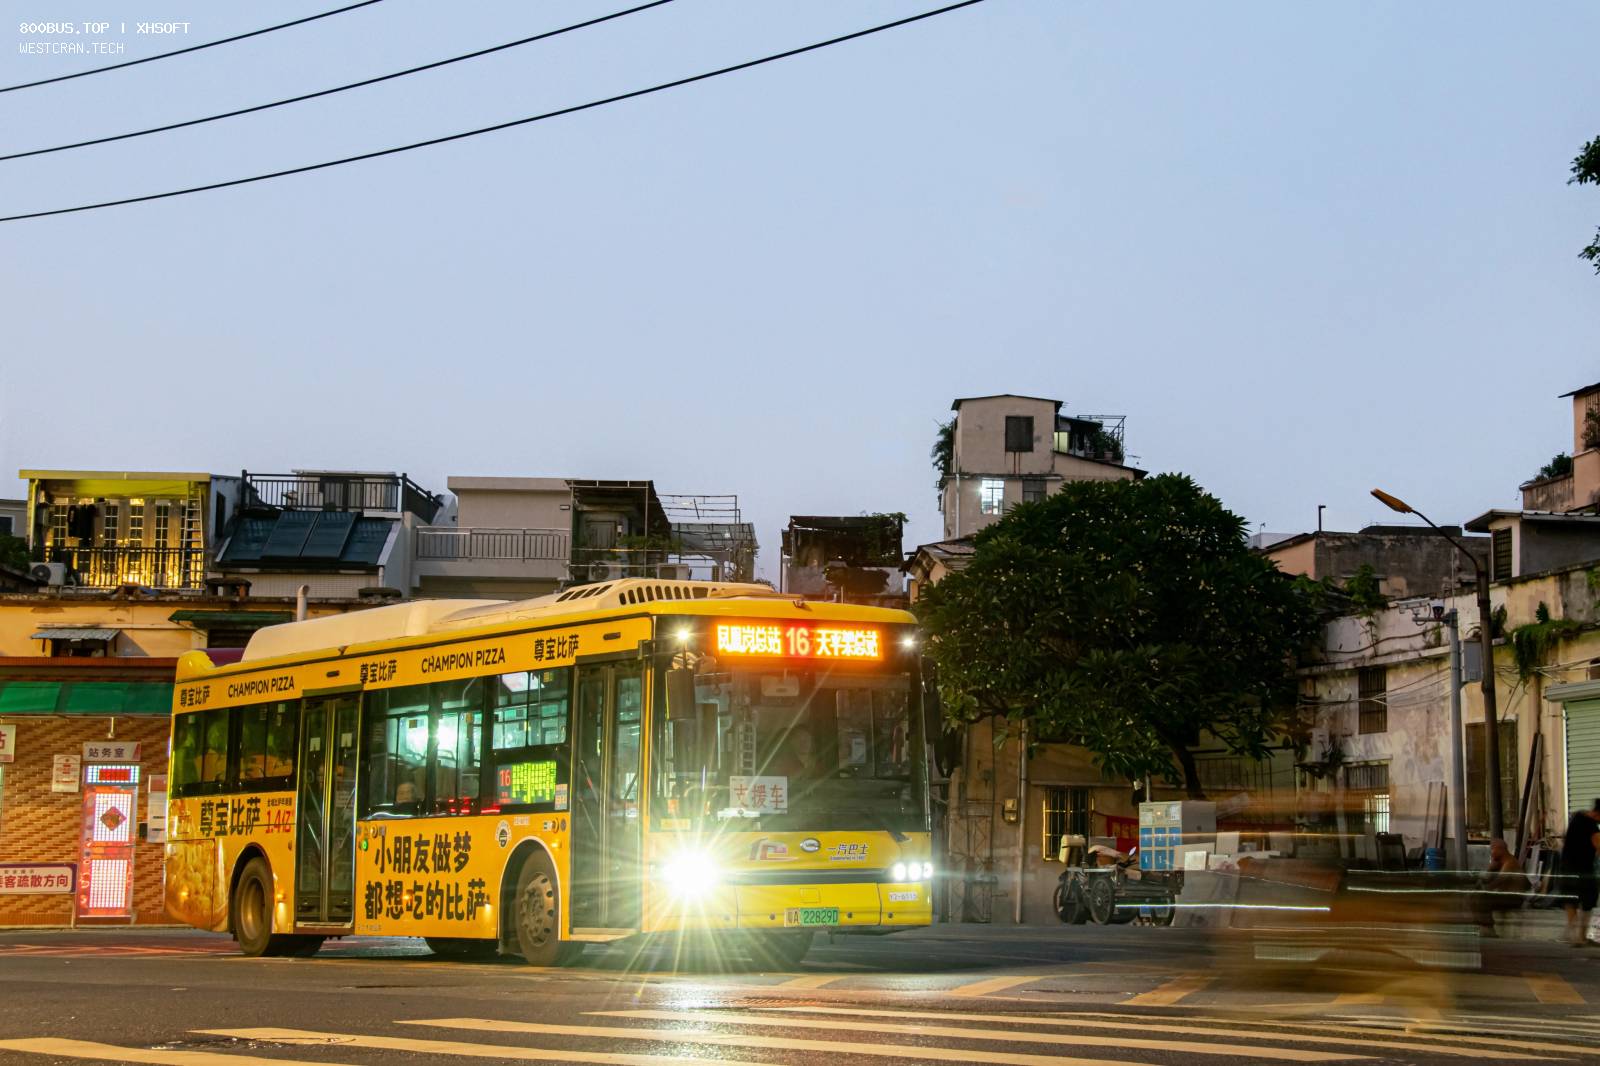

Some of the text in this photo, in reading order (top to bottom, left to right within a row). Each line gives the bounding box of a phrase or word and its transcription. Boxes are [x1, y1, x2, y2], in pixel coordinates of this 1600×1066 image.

[534, 634, 580, 662] 尊宝比萨
[786, 627, 809, 656] 16
[359, 659, 397, 685] 尊宝比萨
[421, 647, 506, 673] CHAMPION PIZZA
[180, 685, 211, 707] 尊宝比萨
[227, 676, 295, 698] CHAMPION PIZZA
[88, 747, 125, 758] 站务室
[499, 769, 512, 787] 16
[734, 783, 784, 809] 支援车
[200, 796, 261, 838] 尊宝比萨
[375, 831, 472, 874] 小朋友做梦
[828, 844, 868, 855] 一汽巴士
[365, 878, 486, 921] 都想吃的比萨
